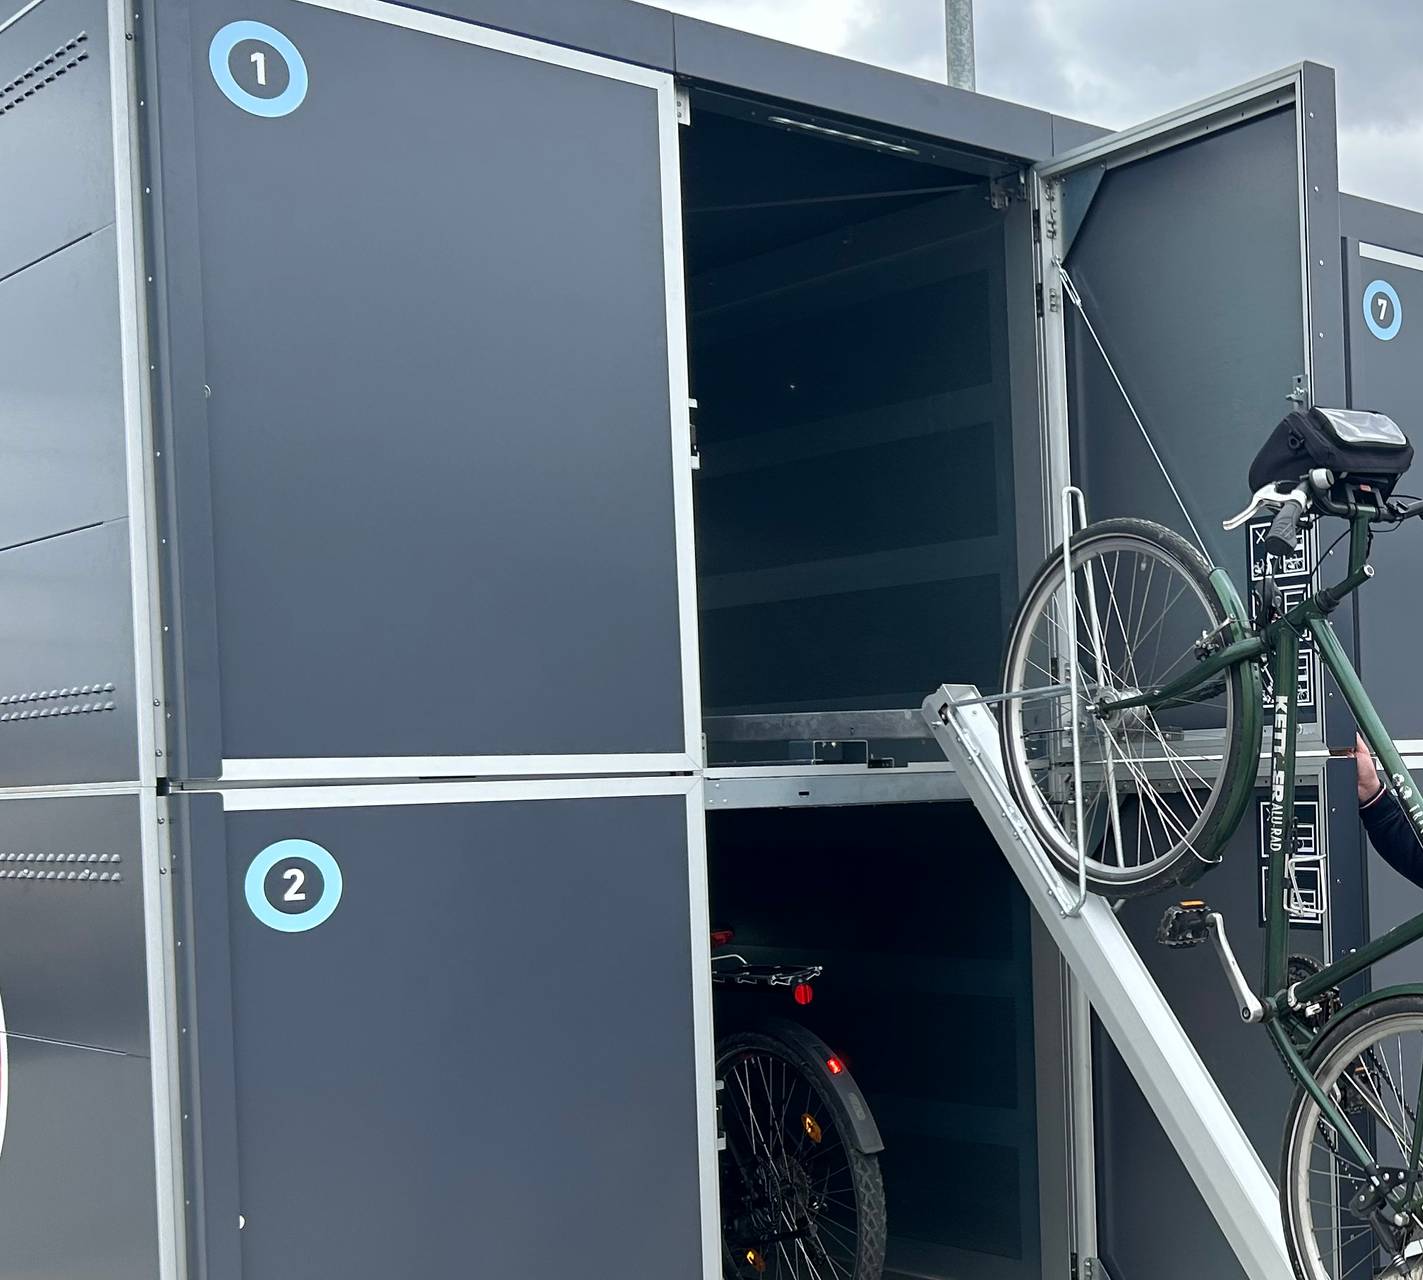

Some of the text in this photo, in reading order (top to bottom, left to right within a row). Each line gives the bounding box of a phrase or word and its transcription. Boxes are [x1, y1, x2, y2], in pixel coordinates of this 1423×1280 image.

[251, 52, 266, 86] 1
[1377, 298, 1388, 321] 7
[1269, 802, 1284, 852] ALU-RAD
[283, 868, 306, 902] 2
